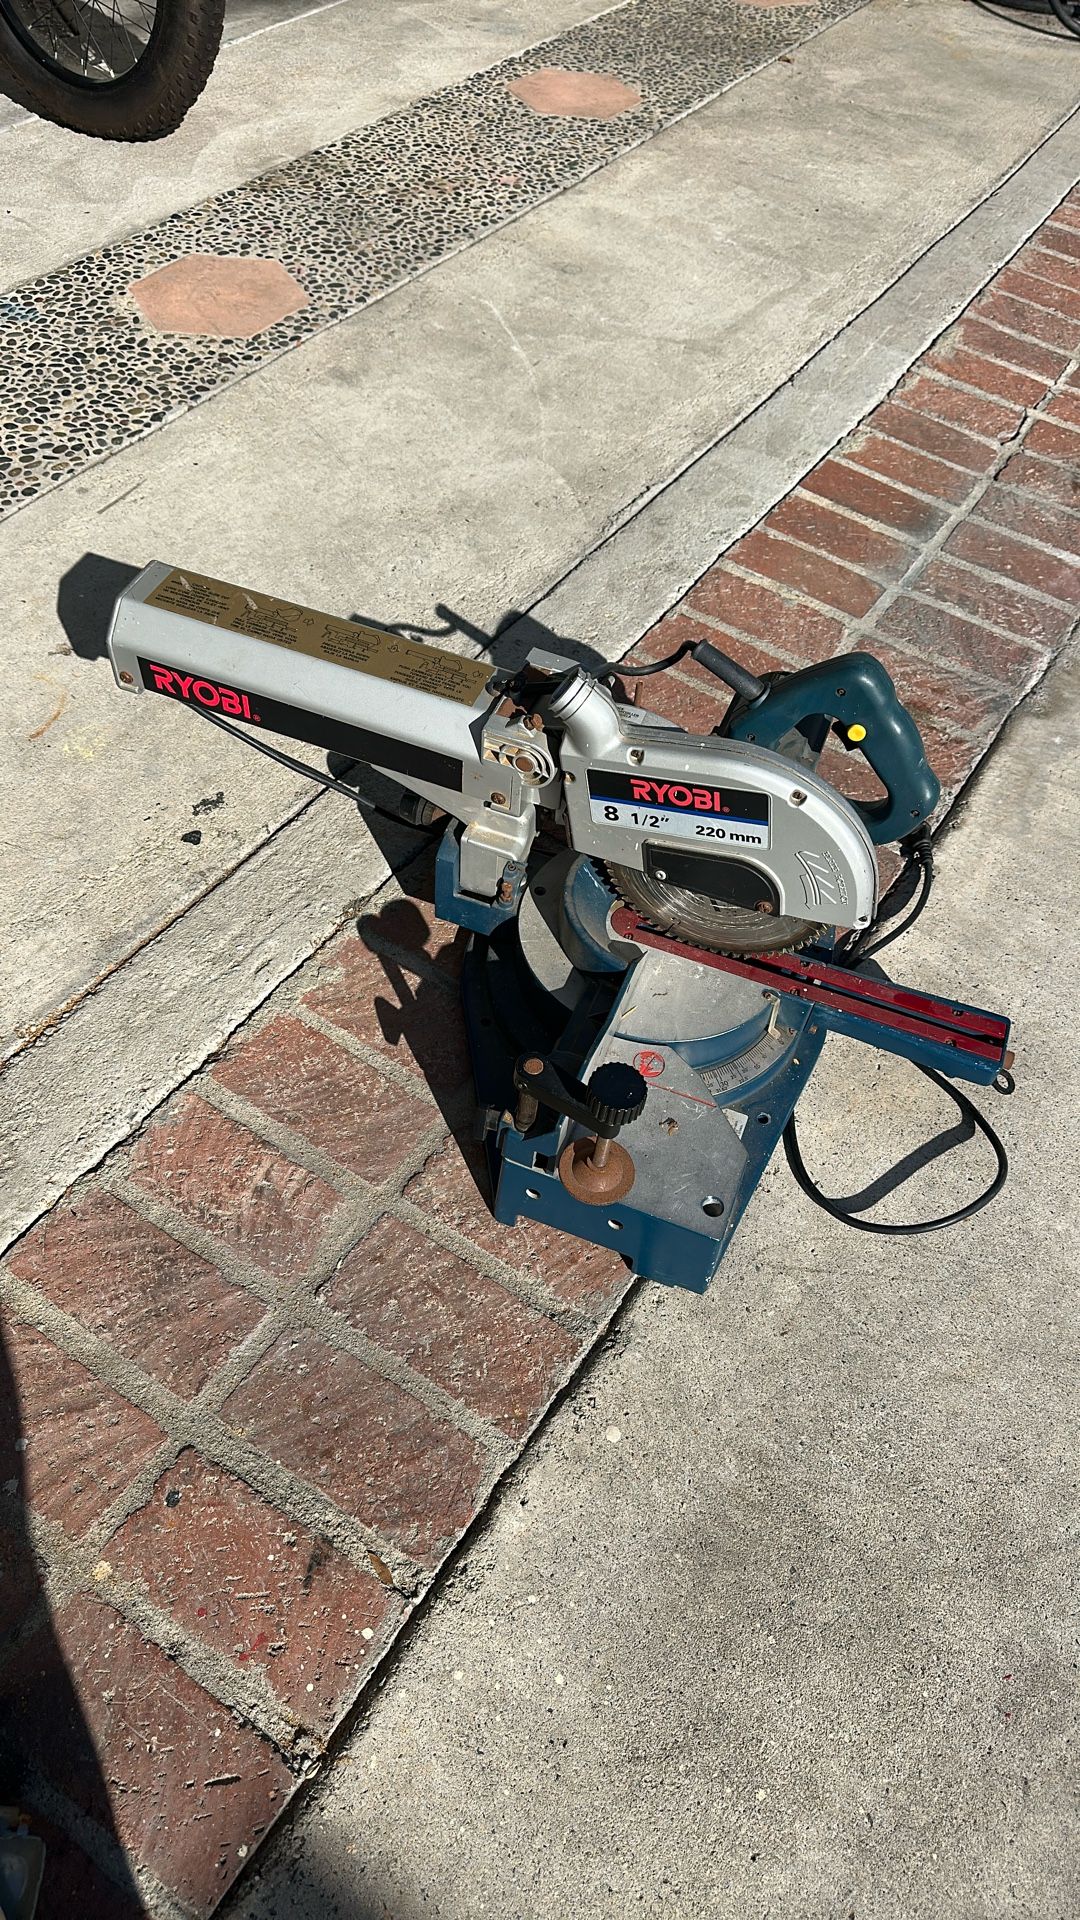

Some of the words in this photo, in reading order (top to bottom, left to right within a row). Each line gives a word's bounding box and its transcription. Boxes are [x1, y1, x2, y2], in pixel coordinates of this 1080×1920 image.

[149, 664, 251, 719] RYOBI
[630, 779, 721, 812] RYOBI
[603, 805, 620, 821] 8
[631, 812, 669, 828] 1/2"
[695, 825, 727, 839] 220
[729, 832, 762, 844] mm
